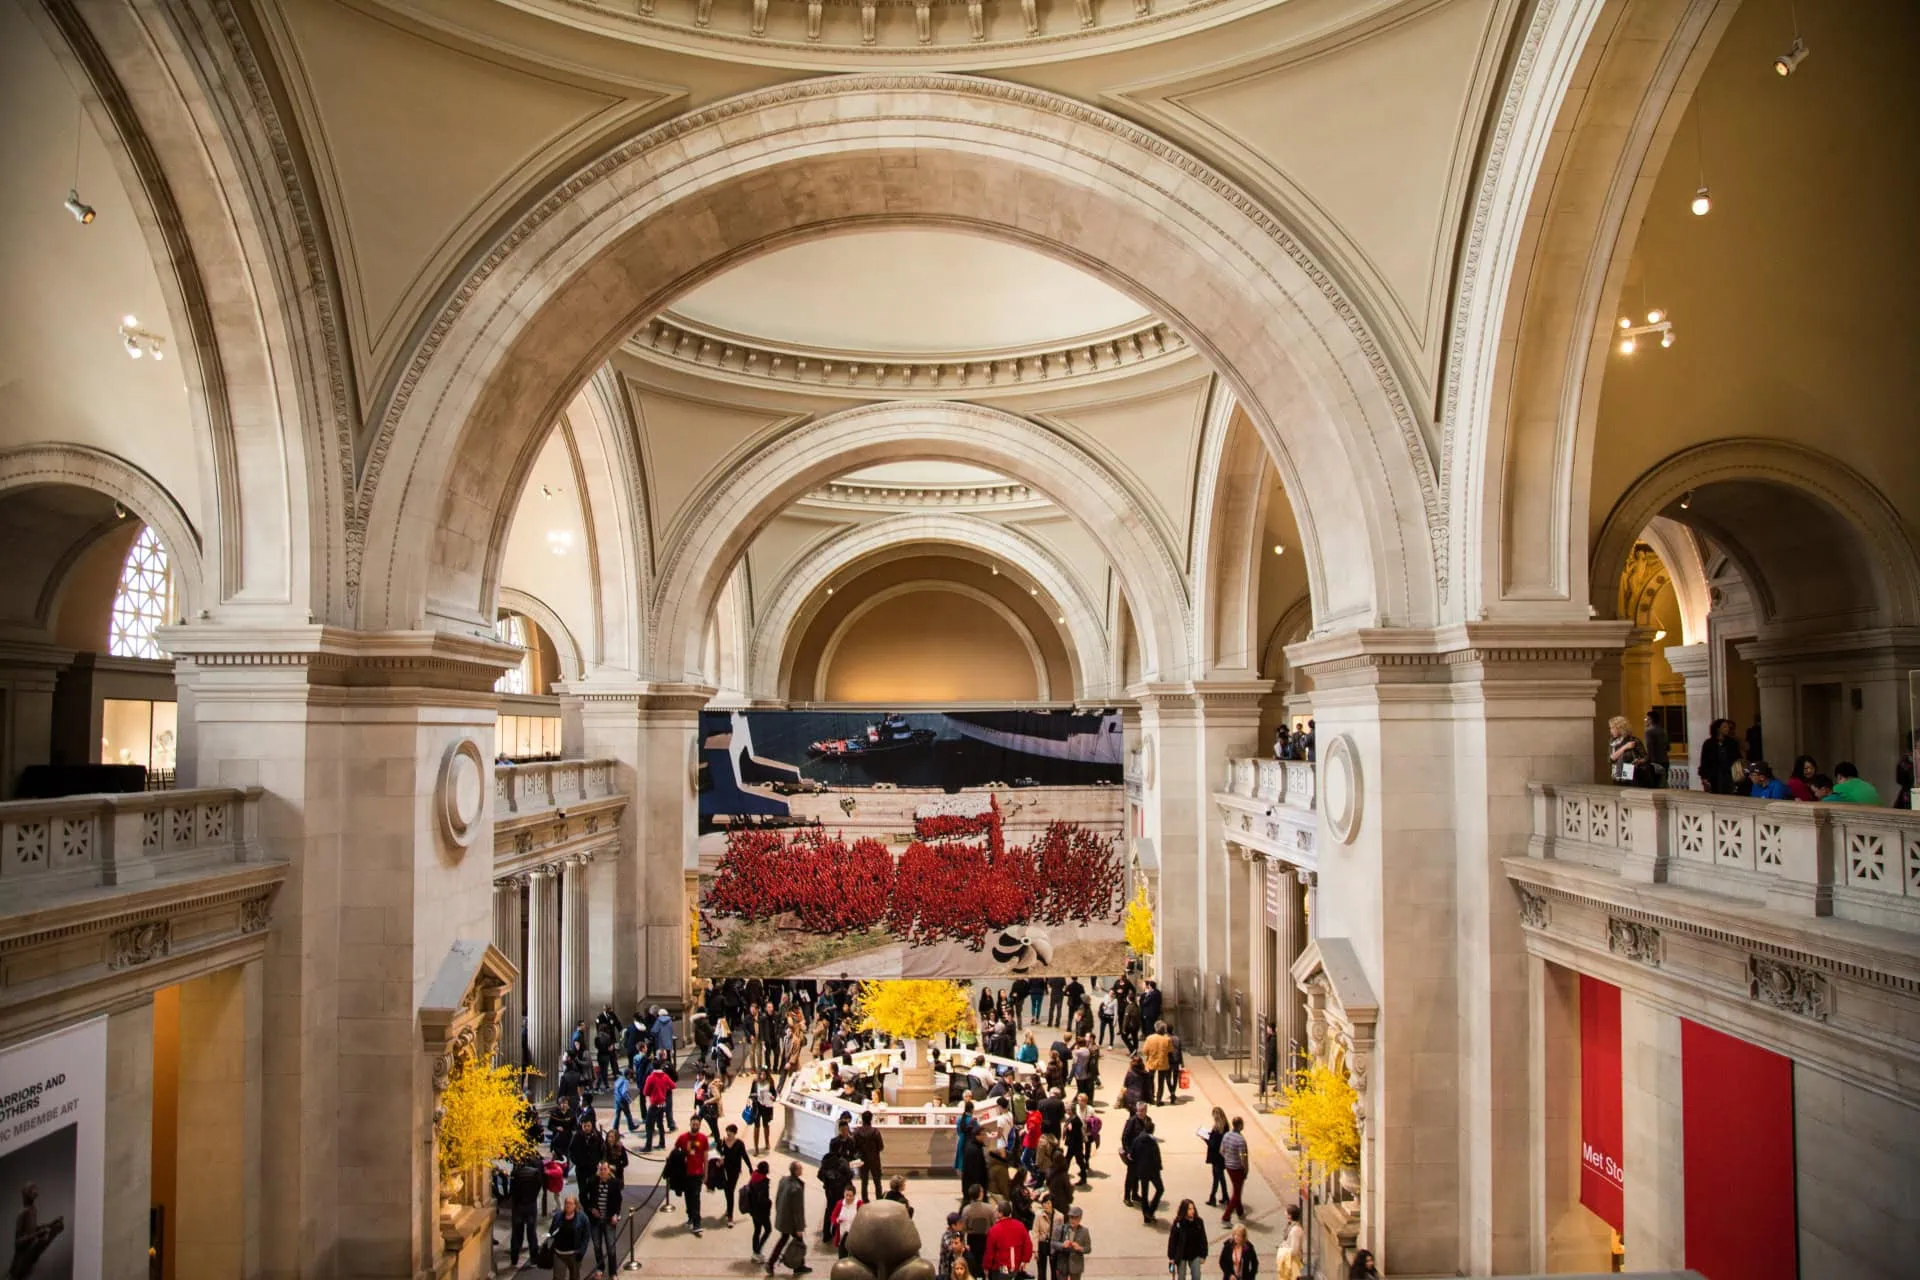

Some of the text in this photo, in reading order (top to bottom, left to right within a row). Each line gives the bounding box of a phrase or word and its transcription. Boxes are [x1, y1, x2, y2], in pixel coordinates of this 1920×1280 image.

[45, 1073, 66, 1091] AND
[13, 1106, 58, 1137] MBEMBE
[60, 1097, 79, 1116] ART
[1583, 1141, 1604, 1170] Met
